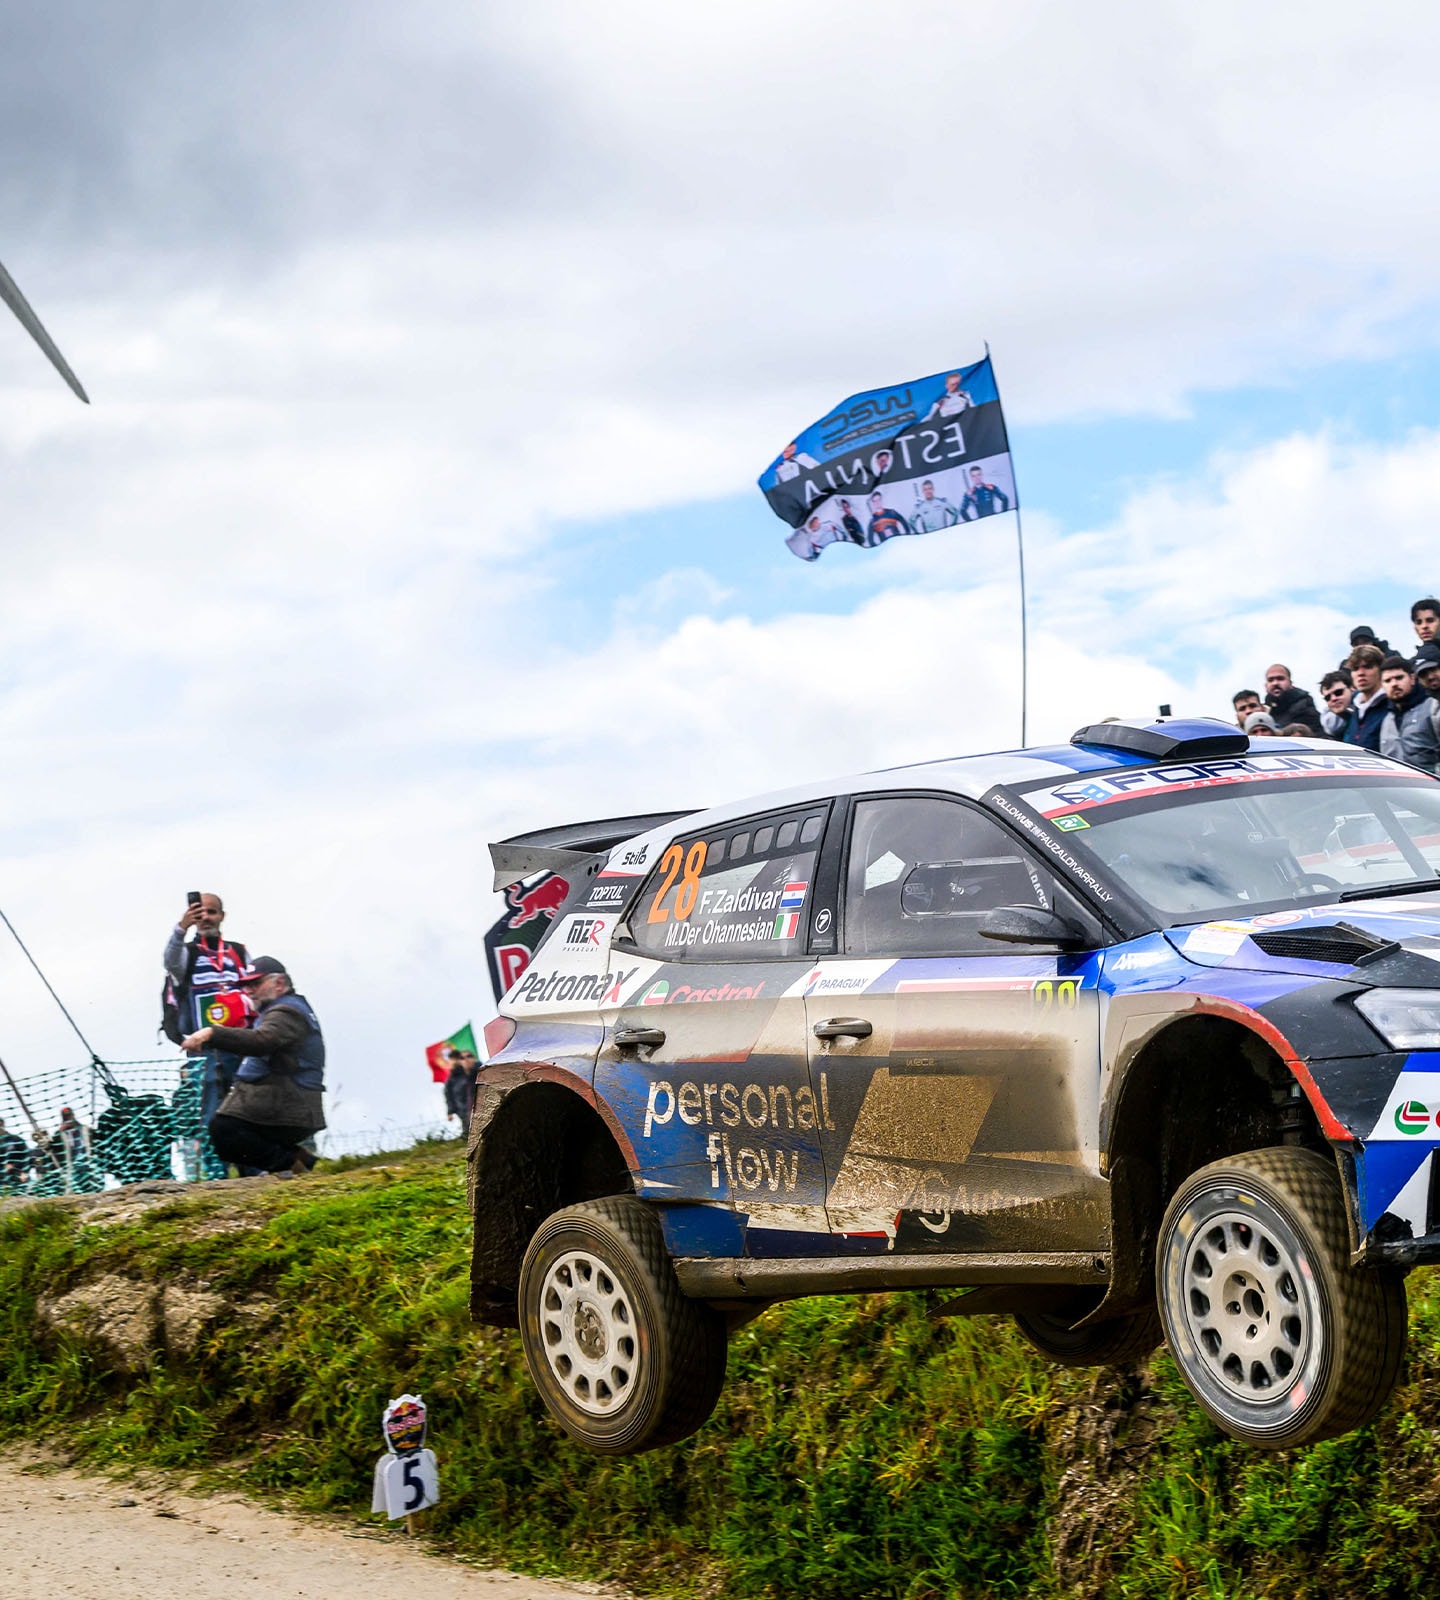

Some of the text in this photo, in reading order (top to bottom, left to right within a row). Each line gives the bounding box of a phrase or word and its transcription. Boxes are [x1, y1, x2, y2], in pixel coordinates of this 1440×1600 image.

[588, 885, 624, 901] TOPTUL
[647, 841, 707, 924] 28
[699, 886, 782, 915] F.Zaldivar
[665, 917, 774, 947] M.Der Ohannesian
[818, 978, 868, 989] PARAGUAY
[643, 1072, 836, 1138] personal
[706, 1131, 799, 1192] flow
[403, 1458, 425, 1511] 5
